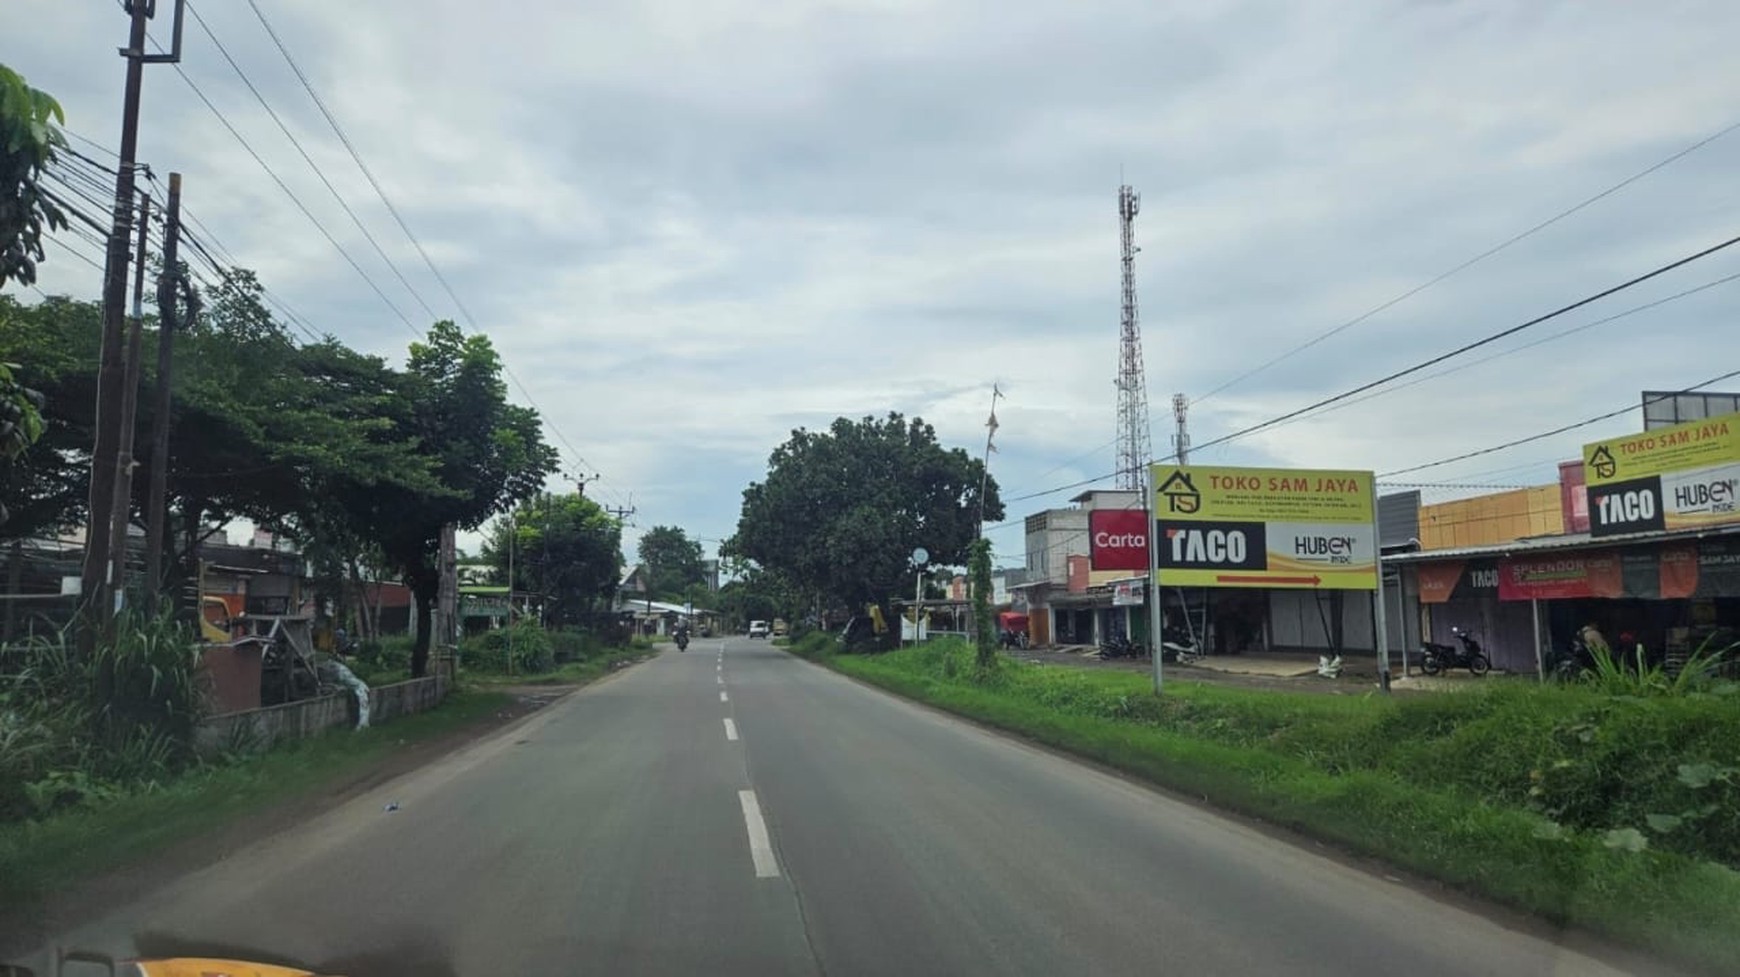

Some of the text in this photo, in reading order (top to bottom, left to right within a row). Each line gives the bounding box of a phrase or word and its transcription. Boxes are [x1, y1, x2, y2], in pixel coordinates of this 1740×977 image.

[1620, 438, 1655, 456] TOKO
[1660, 431, 1690, 449] SAM
[1695, 423, 1730, 442] JAYA
[1209, 475, 1359, 493] TOKO SAM JAYA
[1674, 478, 1734, 508] HUBEN
[1594, 488, 1655, 525] TACO
[1094, 531, 1146, 548] Carta
[1166, 529, 1247, 563] TACO
[1295, 536, 1352, 556] HUBEN
[1512, 560, 1585, 574] SPLENDOR
[1471, 569, 1499, 588] TACO
